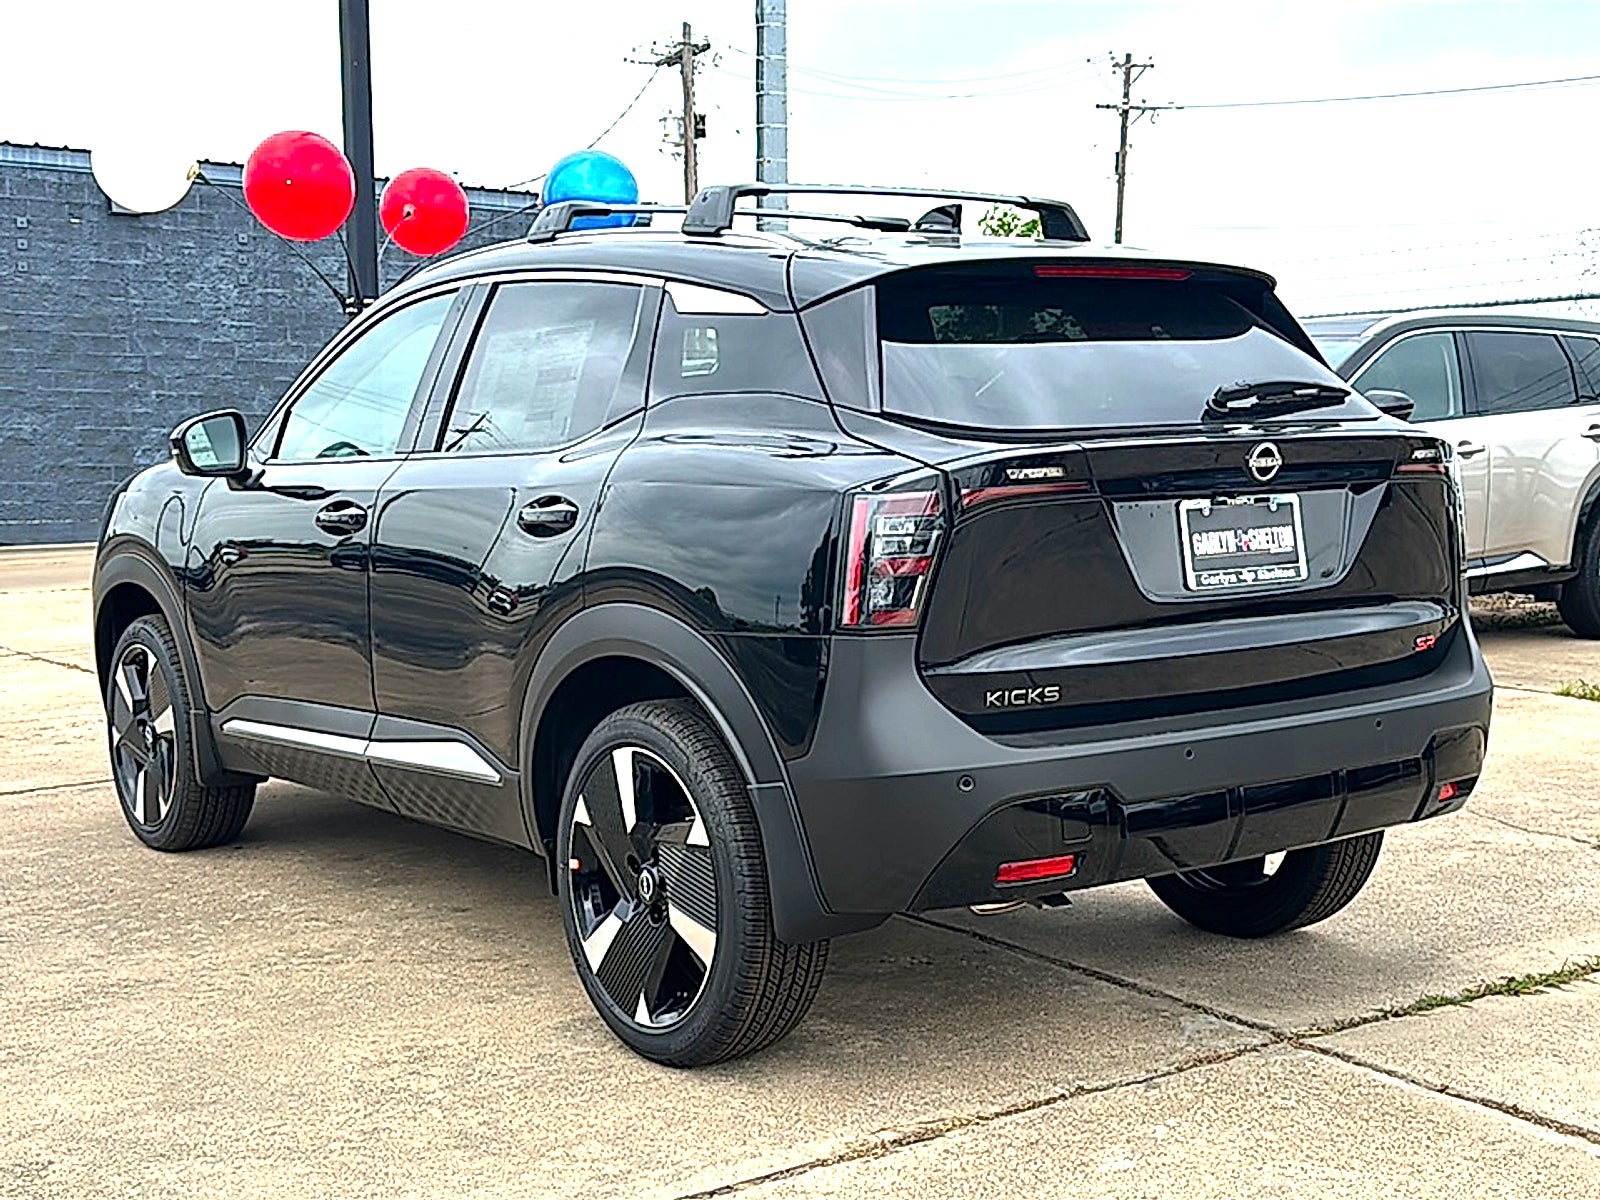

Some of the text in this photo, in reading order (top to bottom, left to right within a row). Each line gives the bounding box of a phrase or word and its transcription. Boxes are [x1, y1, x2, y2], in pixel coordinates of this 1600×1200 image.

[1248, 526, 1293, 550] SHELTON
[1414, 636, 1437, 651] SR
[985, 686, 1060, 707] KICKS
